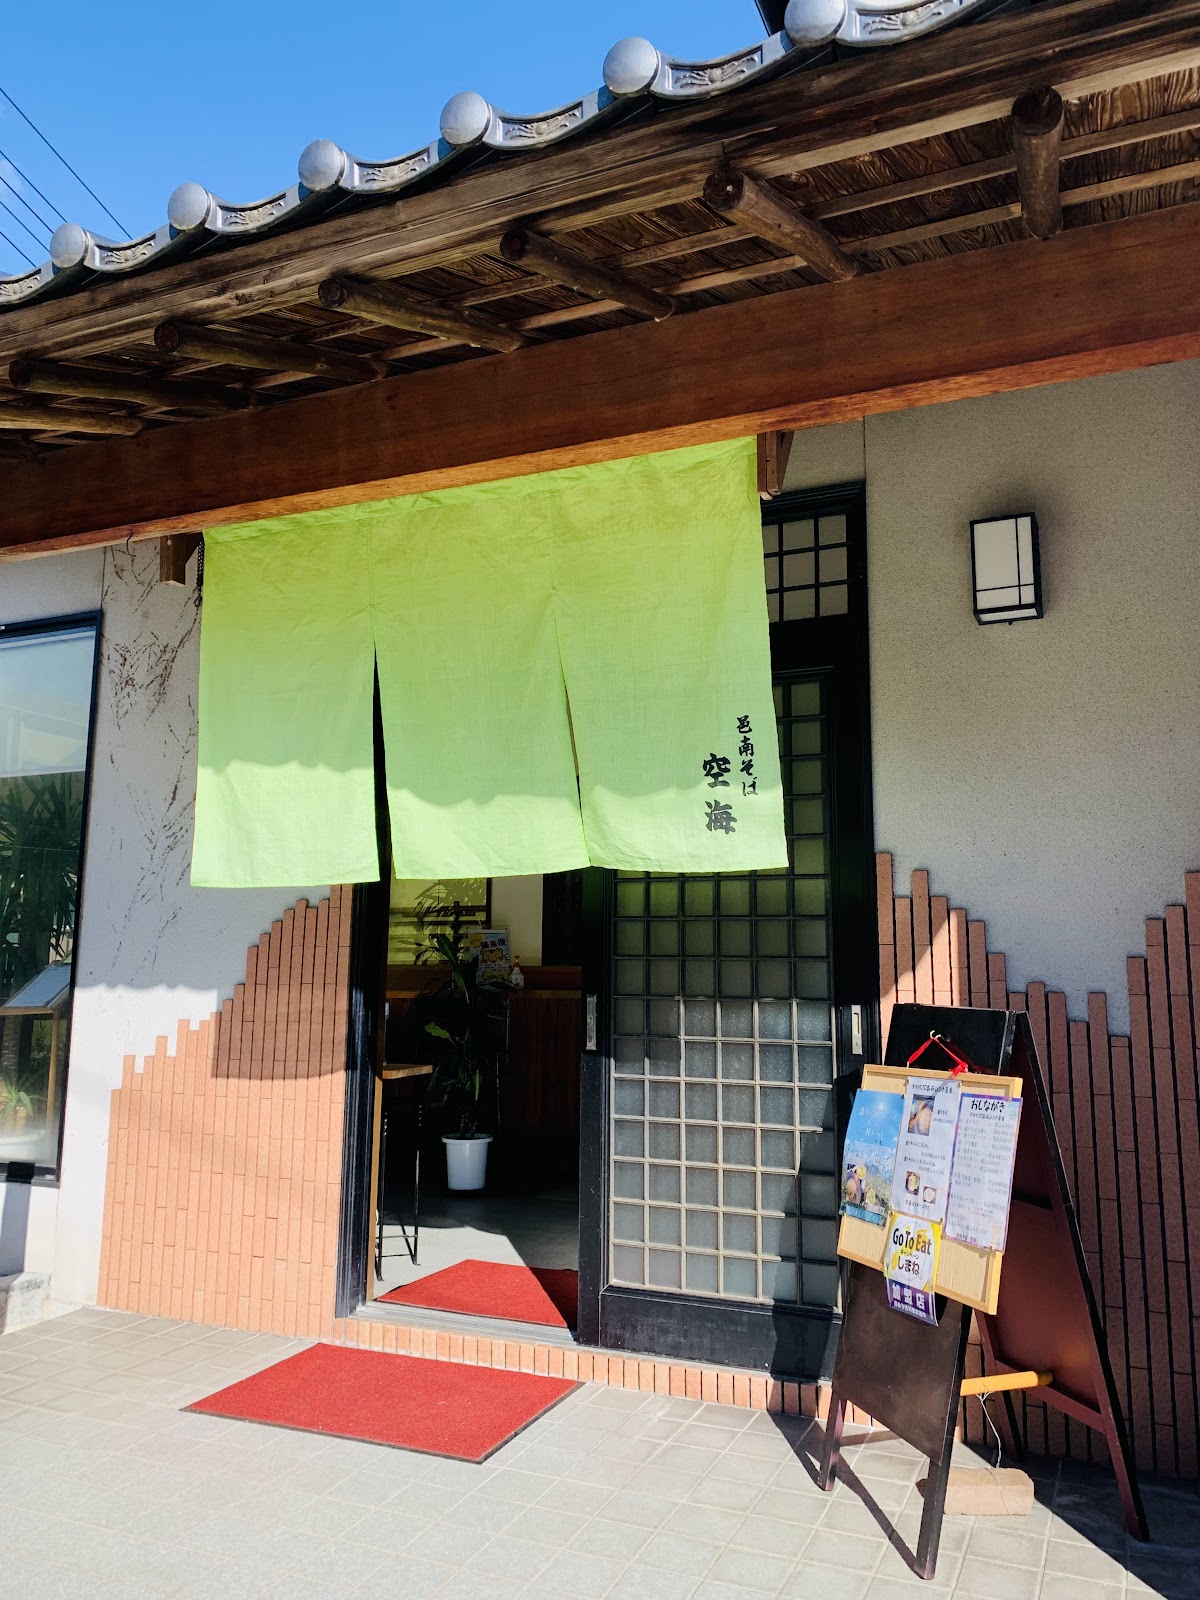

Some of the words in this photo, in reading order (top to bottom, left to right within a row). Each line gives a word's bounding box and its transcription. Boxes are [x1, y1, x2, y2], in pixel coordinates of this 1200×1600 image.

[736, 714, 759, 797] 邑南そば
[702, 752, 738, 835] 空海
[970, 1099, 1006, 1113] おしながき
[892, 1227, 904, 1247] Go
[905, 1230, 915, 1250] To
[916, 1234, 932, 1256] Eat
[892, 1283, 926, 1311] 加盟店
